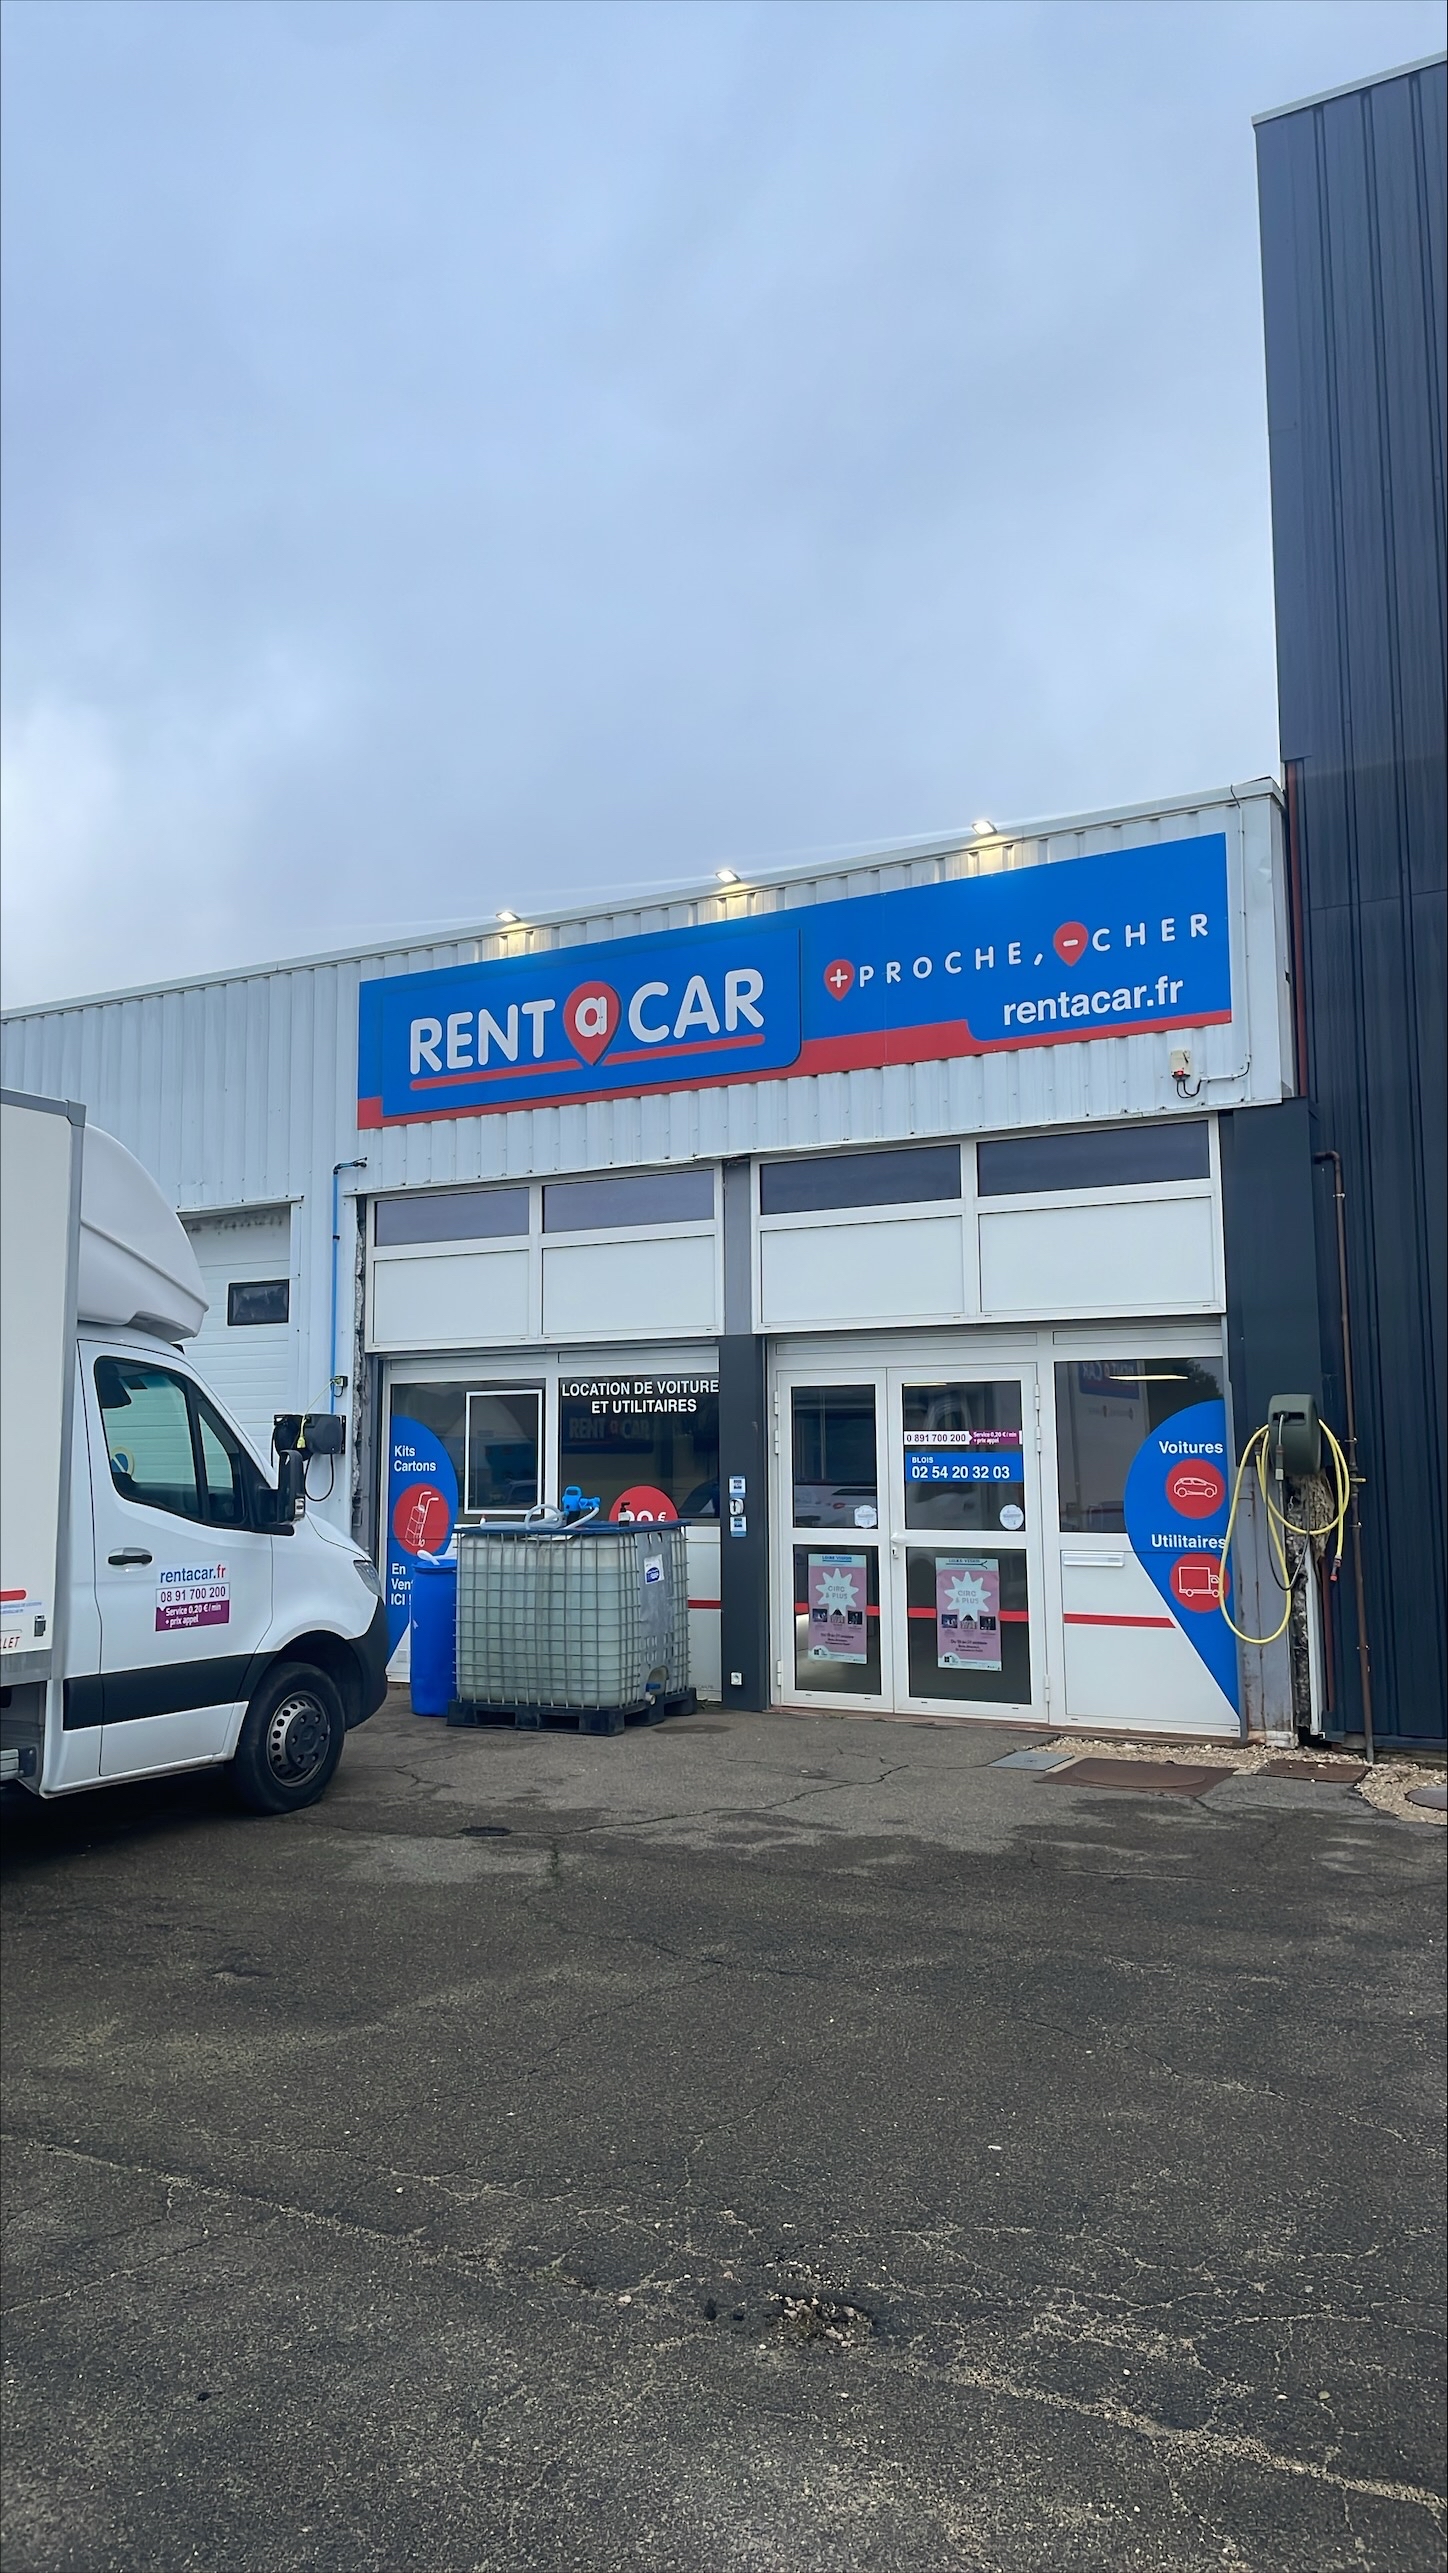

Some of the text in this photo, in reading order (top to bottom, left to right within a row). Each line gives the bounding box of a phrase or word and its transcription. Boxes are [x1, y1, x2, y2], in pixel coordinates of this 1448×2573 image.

[1092, 914, 1209, 952] CHER
[1003, 976, 1183, 1026] rentacar.fr
[410, 968, 765, 1076] RENT a CAR
[562, 1379, 720, 1397] LOCATION DE VOITURE
[591, 1398, 697, 1414] ET UTILITAIRES
[914, 1434, 929, 1442] 891
[931, 1434, 948, 1442] 700
[950, 1433, 966, 1442] 200
[394, 1445, 416, 1457] Kits
[1159, 1440, 1223, 1454] Voitures
[393, 1459, 437, 1472] Cartons
[912, 1456, 934, 1464] BLOIS
[911, 1465, 1010, 1479] 02 54 20 32 03
[1151, 1533, 1227, 1549] Utilitaires
[160, 1564, 226, 1583] rentacar.fr
[391, 1562, 406, 1575] En
[160, 1586, 226, 1603] 08 91 700 200
[827, 1585, 846, 1593] CIRC
[831, 1592, 848, 1600] PLUS
[957, 1589, 977, 1597] CIRC
[390, 1593, 406, 1606] ICI
[165, 1606, 188, 1617] Service
[188, 1604, 203, 1614] 0,20
[170, 1616, 182, 1628] prix
[182, 1614, 199, 1626] appel
